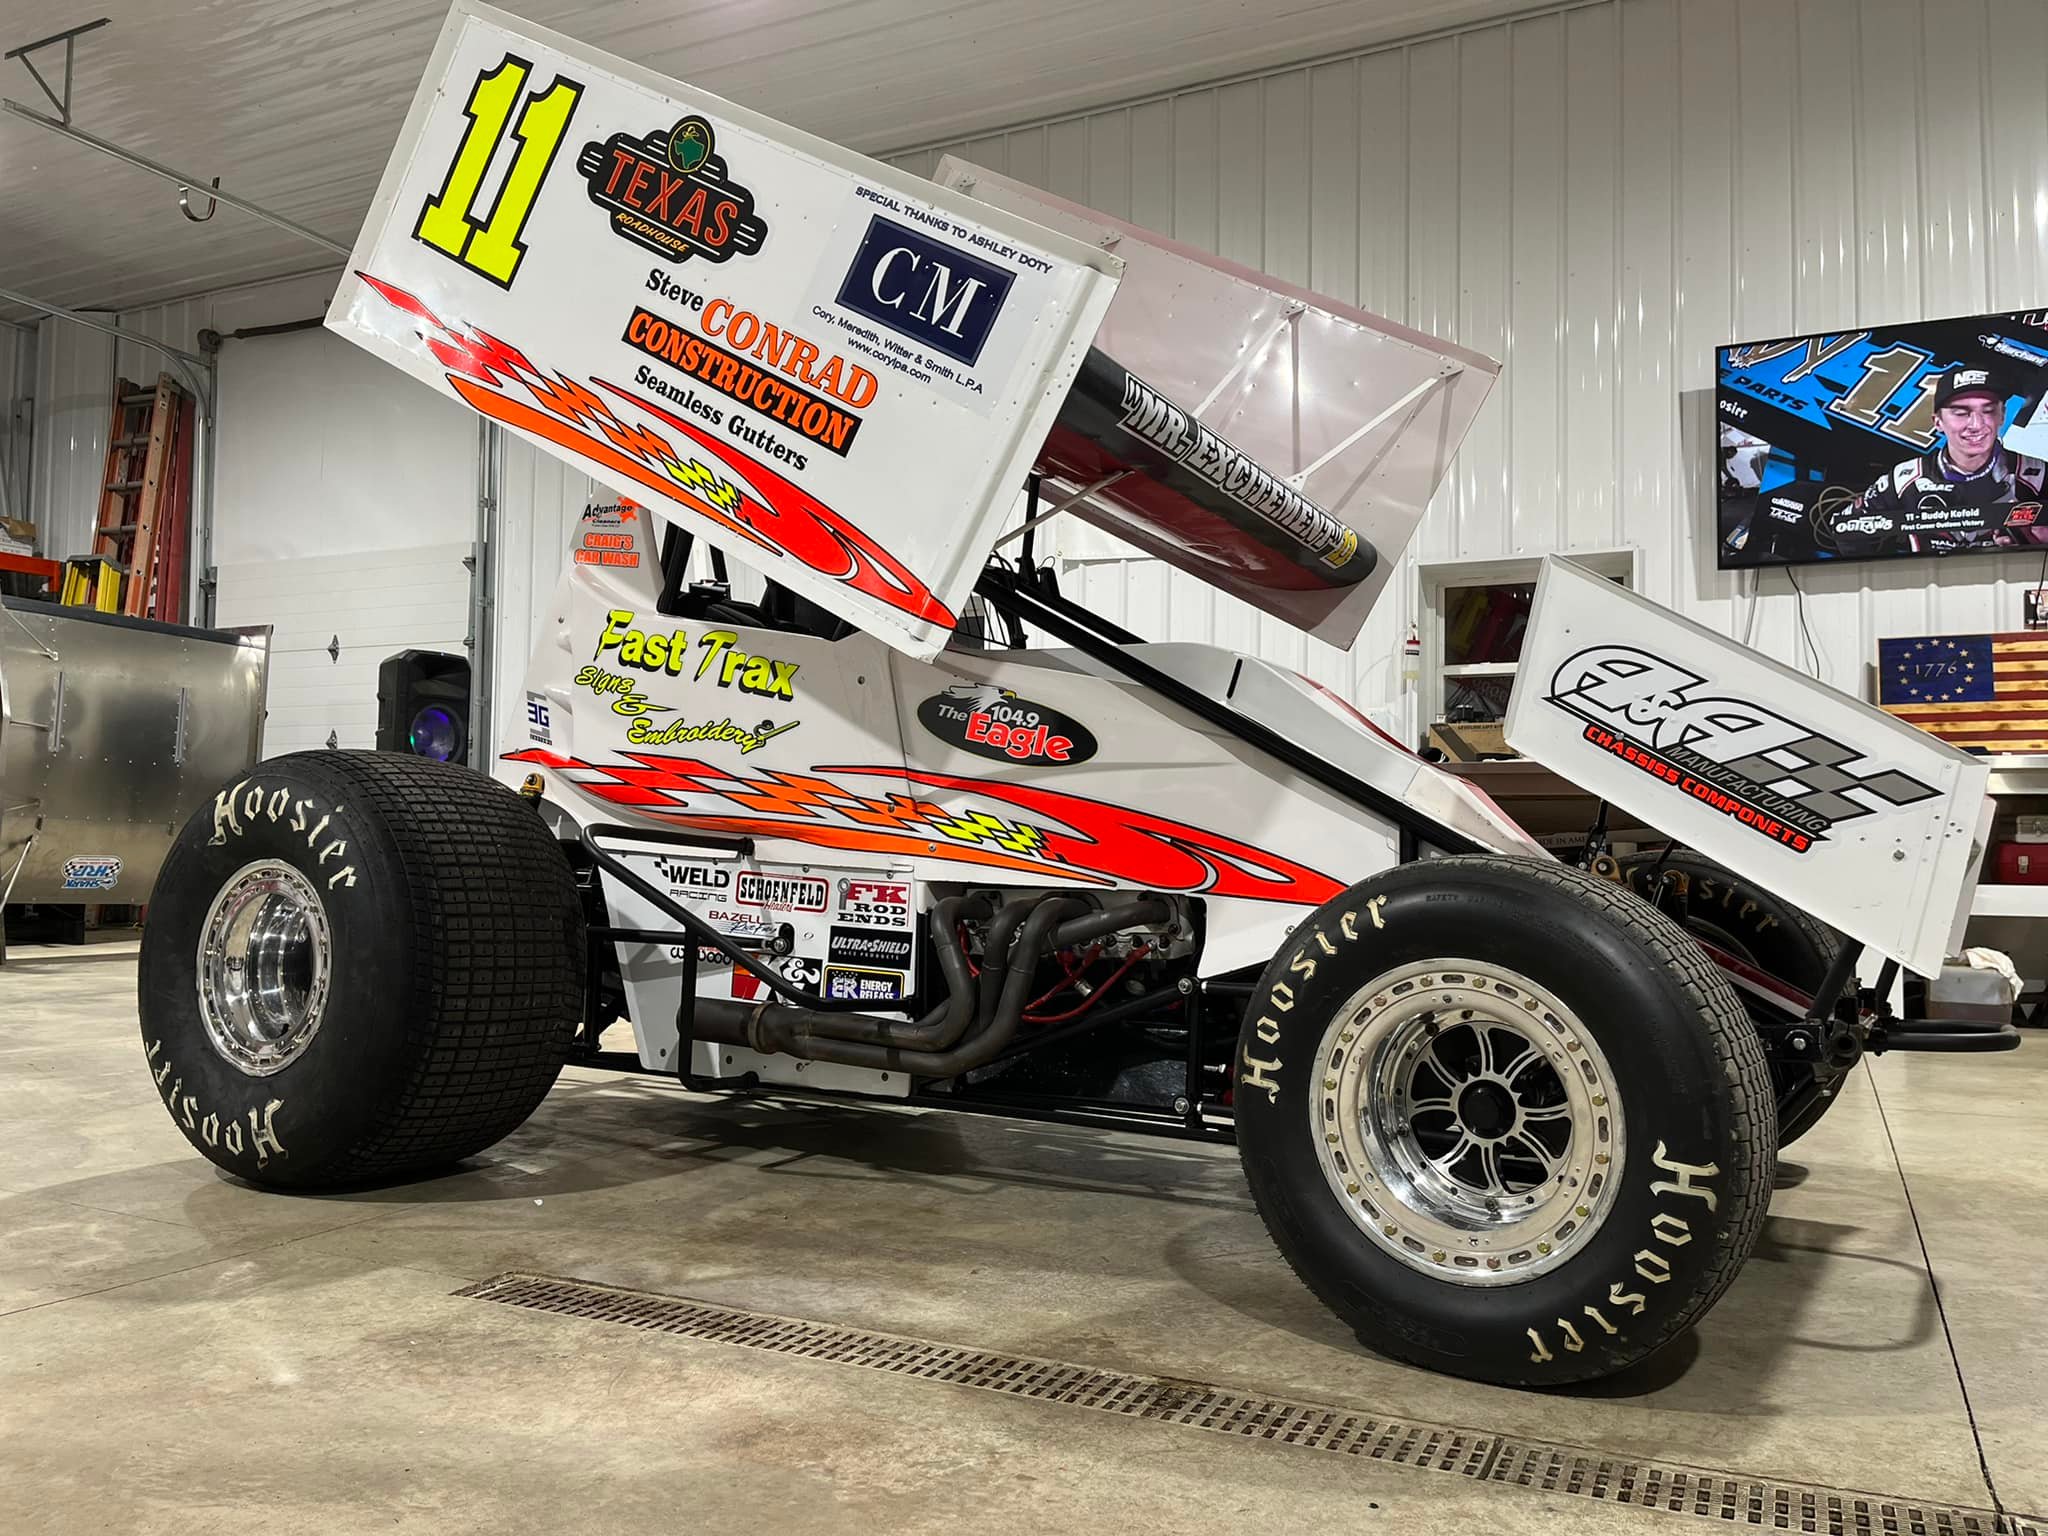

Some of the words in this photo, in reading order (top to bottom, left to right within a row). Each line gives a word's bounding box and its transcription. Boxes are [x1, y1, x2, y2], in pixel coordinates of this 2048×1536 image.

[411, 52, 584, 291] 11
[605, 149, 738, 247] TEXAS
[616, 212, 690, 253] ROADHOUSE
[855, 186, 901, 213] SPECIAL
[904, 205, 950, 232] THANKS
[951, 224, 968, 239] TO
[967, 232, 1018, 262] ASHLEY
[1018, 252, 1053, 275] DOTY
[871, 247, 988, 339] CM
[645, 267, 704, 312] Steve
[700, 298, 879, 410] CONRAD
[811, 305, 836, 325] Cory,
[836, 315, 881, 347] Meredith,
[884, 338, 915, 361] Witter
[914, 356, 924, 366] &
[924, 358, 955, 381] Smith
[628, 311, 855, 450] CONSTRUCTION
[847, 337, 932, 385] www.corylpa.com
[1732, 375, 1809, 411] PARTS
[634, 364, 724, 426] Seamless
[727, 414, 809, 472] Gutters
[1921, 509, 1950, 522] Buddy
[574, 548, 601, 566] CAR
[601, 551, 641, 569] WASH
[583, 532, 634, 551] CRAIG'S
[593, 609, 688, 678] Fast
[693, 630, 801, 702] Trax
[1913, 662, 1958, 678] 1776
[574, 665, 637, 695] Signs
[611, 693, 679, 716] &
[938, 703, 969, 722] The
[990, 704, 1041, 728] 104.9
[626, 717, 767, 756] Embroidery
[964, 711, 1074, 762] Eagle
[1664, 744, 1833, 833] MANUFACTURING
[207, 777, 359, 891] Hoosier
[1680, 776, 1812, 854] COMPONETS
[669, 863, 731, 889] WELD
[669, 888, 728, 903] RACING
[739, 876, 825, 908] SCHOENFELD
[846, 882, 908, 905] FK
[708, 910, 762, 925] BAZELL
[836, 912, 907, 928] ENDS
[853, 902, 907, 916] ROD
[860, 979, 893, 993] ENERGY
[1240, 894, 1389, 1105] Hoosier
[144, 1039, 290, 1171] Hoosier
[1526, 1138, 1723, 1366] Hoosier
